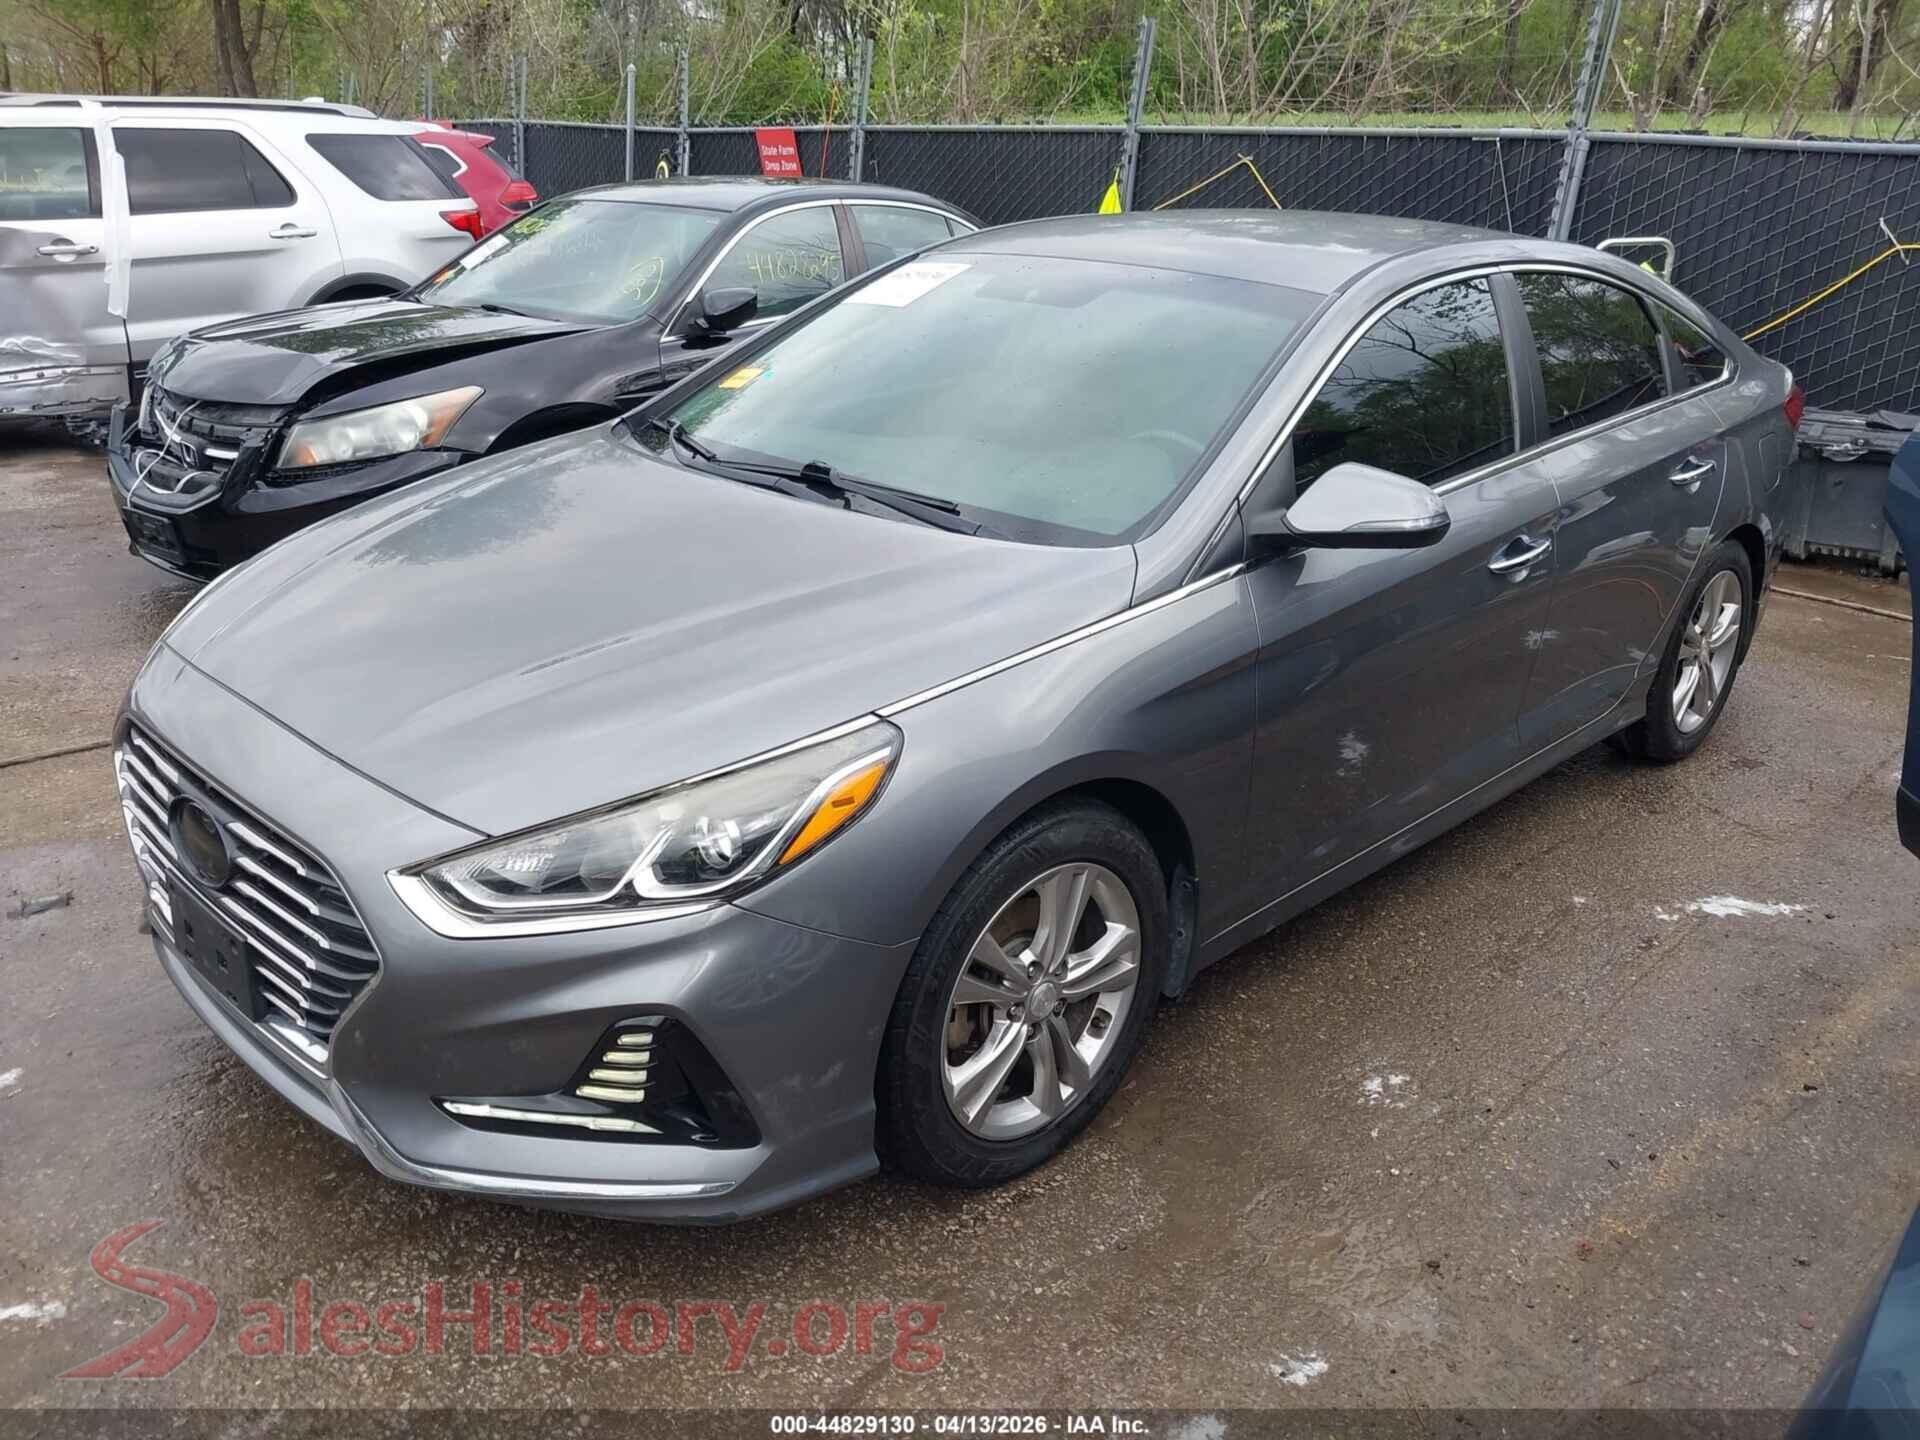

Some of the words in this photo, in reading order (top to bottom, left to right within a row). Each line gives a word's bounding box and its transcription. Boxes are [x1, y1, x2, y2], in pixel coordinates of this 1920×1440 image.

[761, 145, 777, 156] State
[778, 145, 795, 156] Farm
[765, 160, 780, 172] Drop
[781, 160, 797, 171] Zone
